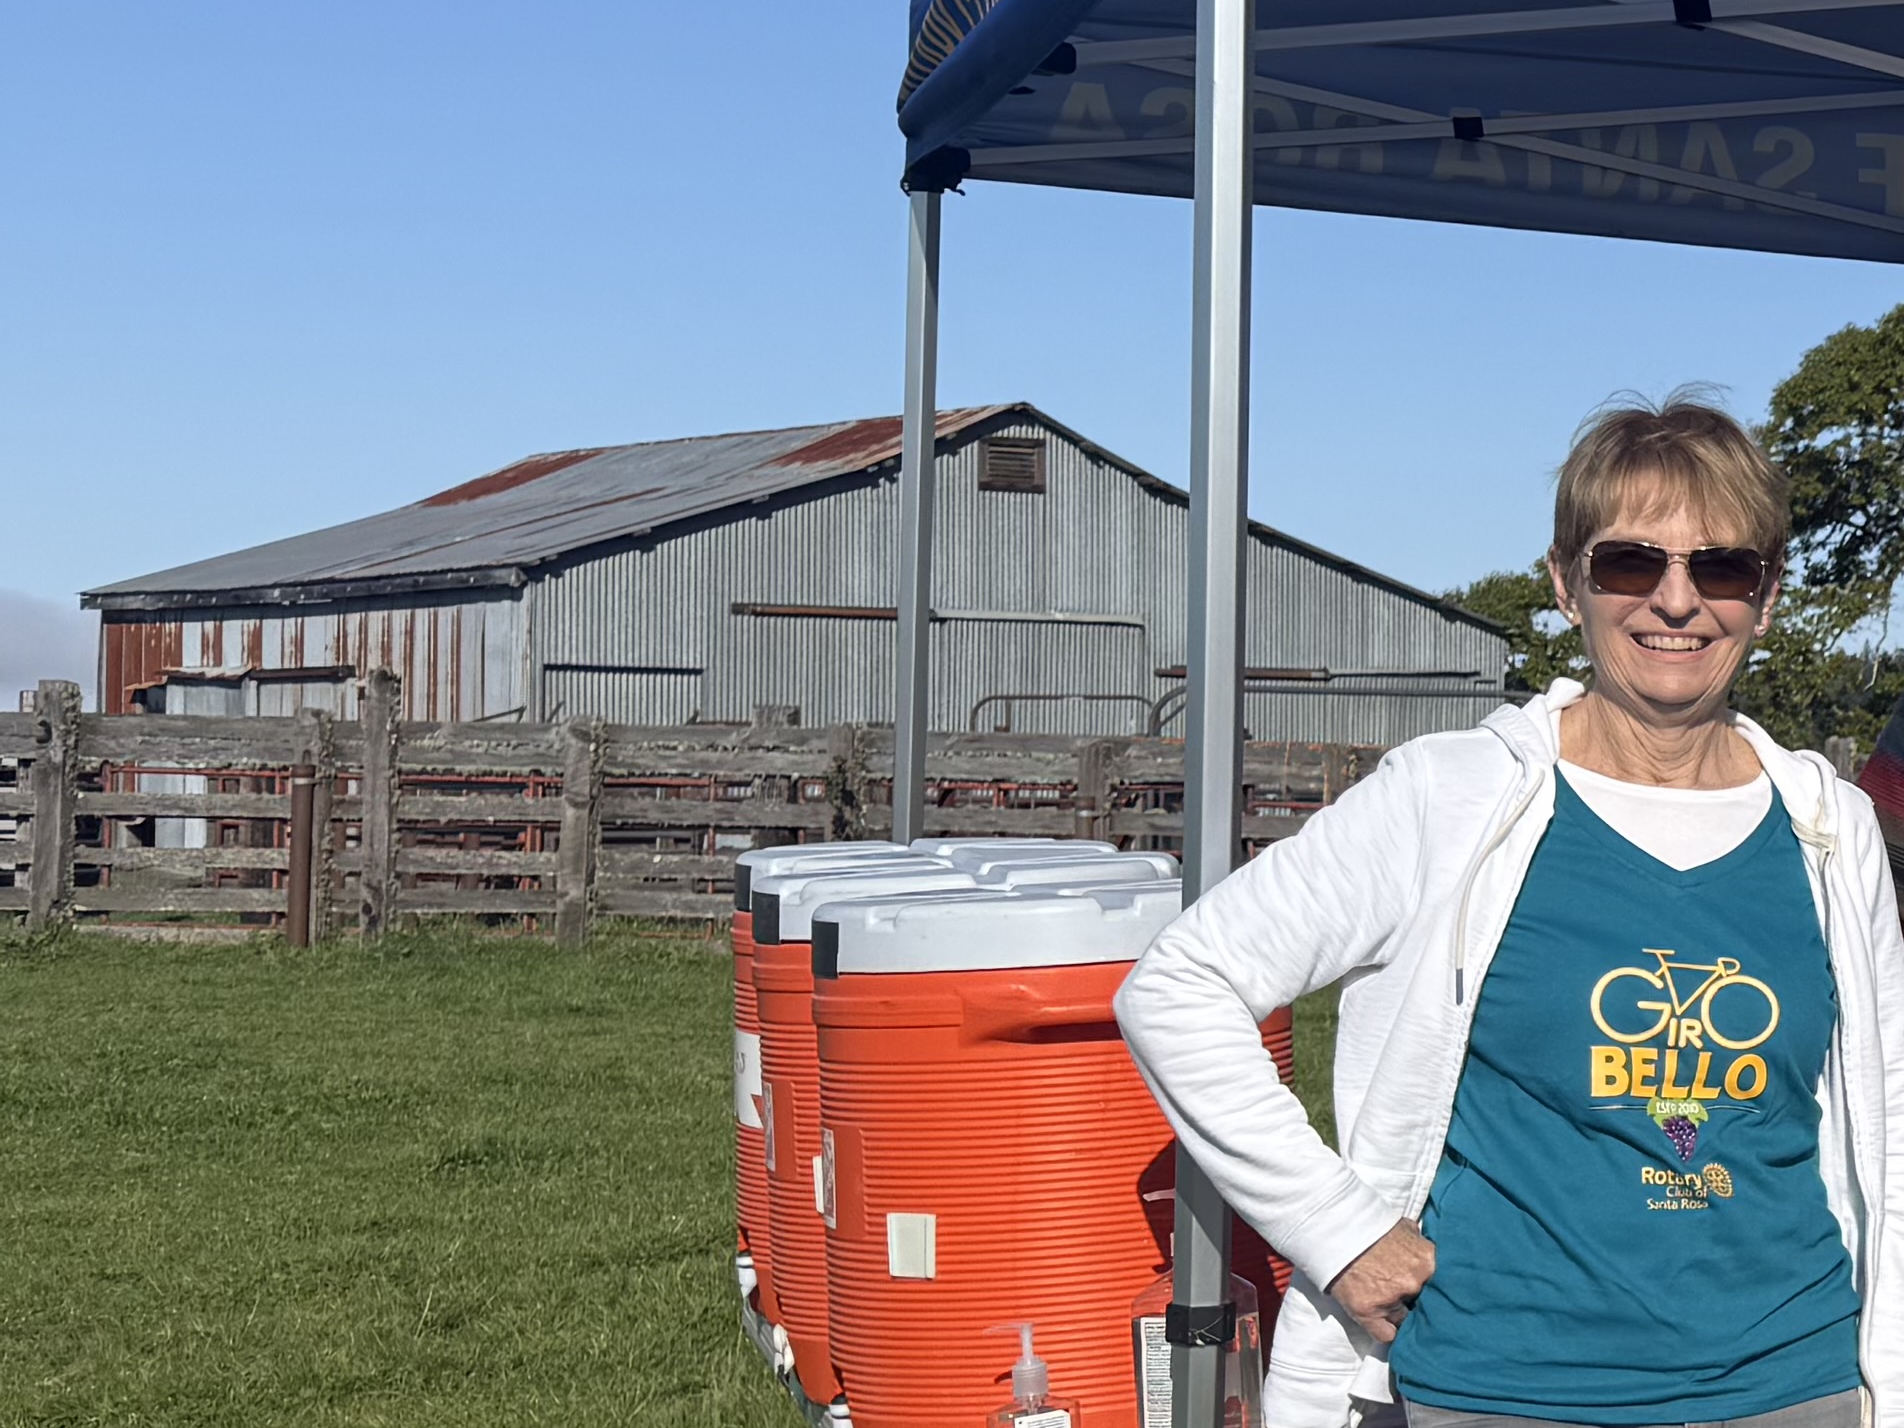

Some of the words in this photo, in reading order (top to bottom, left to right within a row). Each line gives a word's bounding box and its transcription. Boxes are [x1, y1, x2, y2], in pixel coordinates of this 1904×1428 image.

[1590, 1046, 1768, 1101] BELLO
[1641, 1166, 1702, 1190] Rotary
[1666, 1186, 1692, 1197] Club
[1695, 1186, 1708, 1198] of
[1646, 1198, 1678, 1210] Santa
[1681, 1198, 1708, 1210] Rosa
